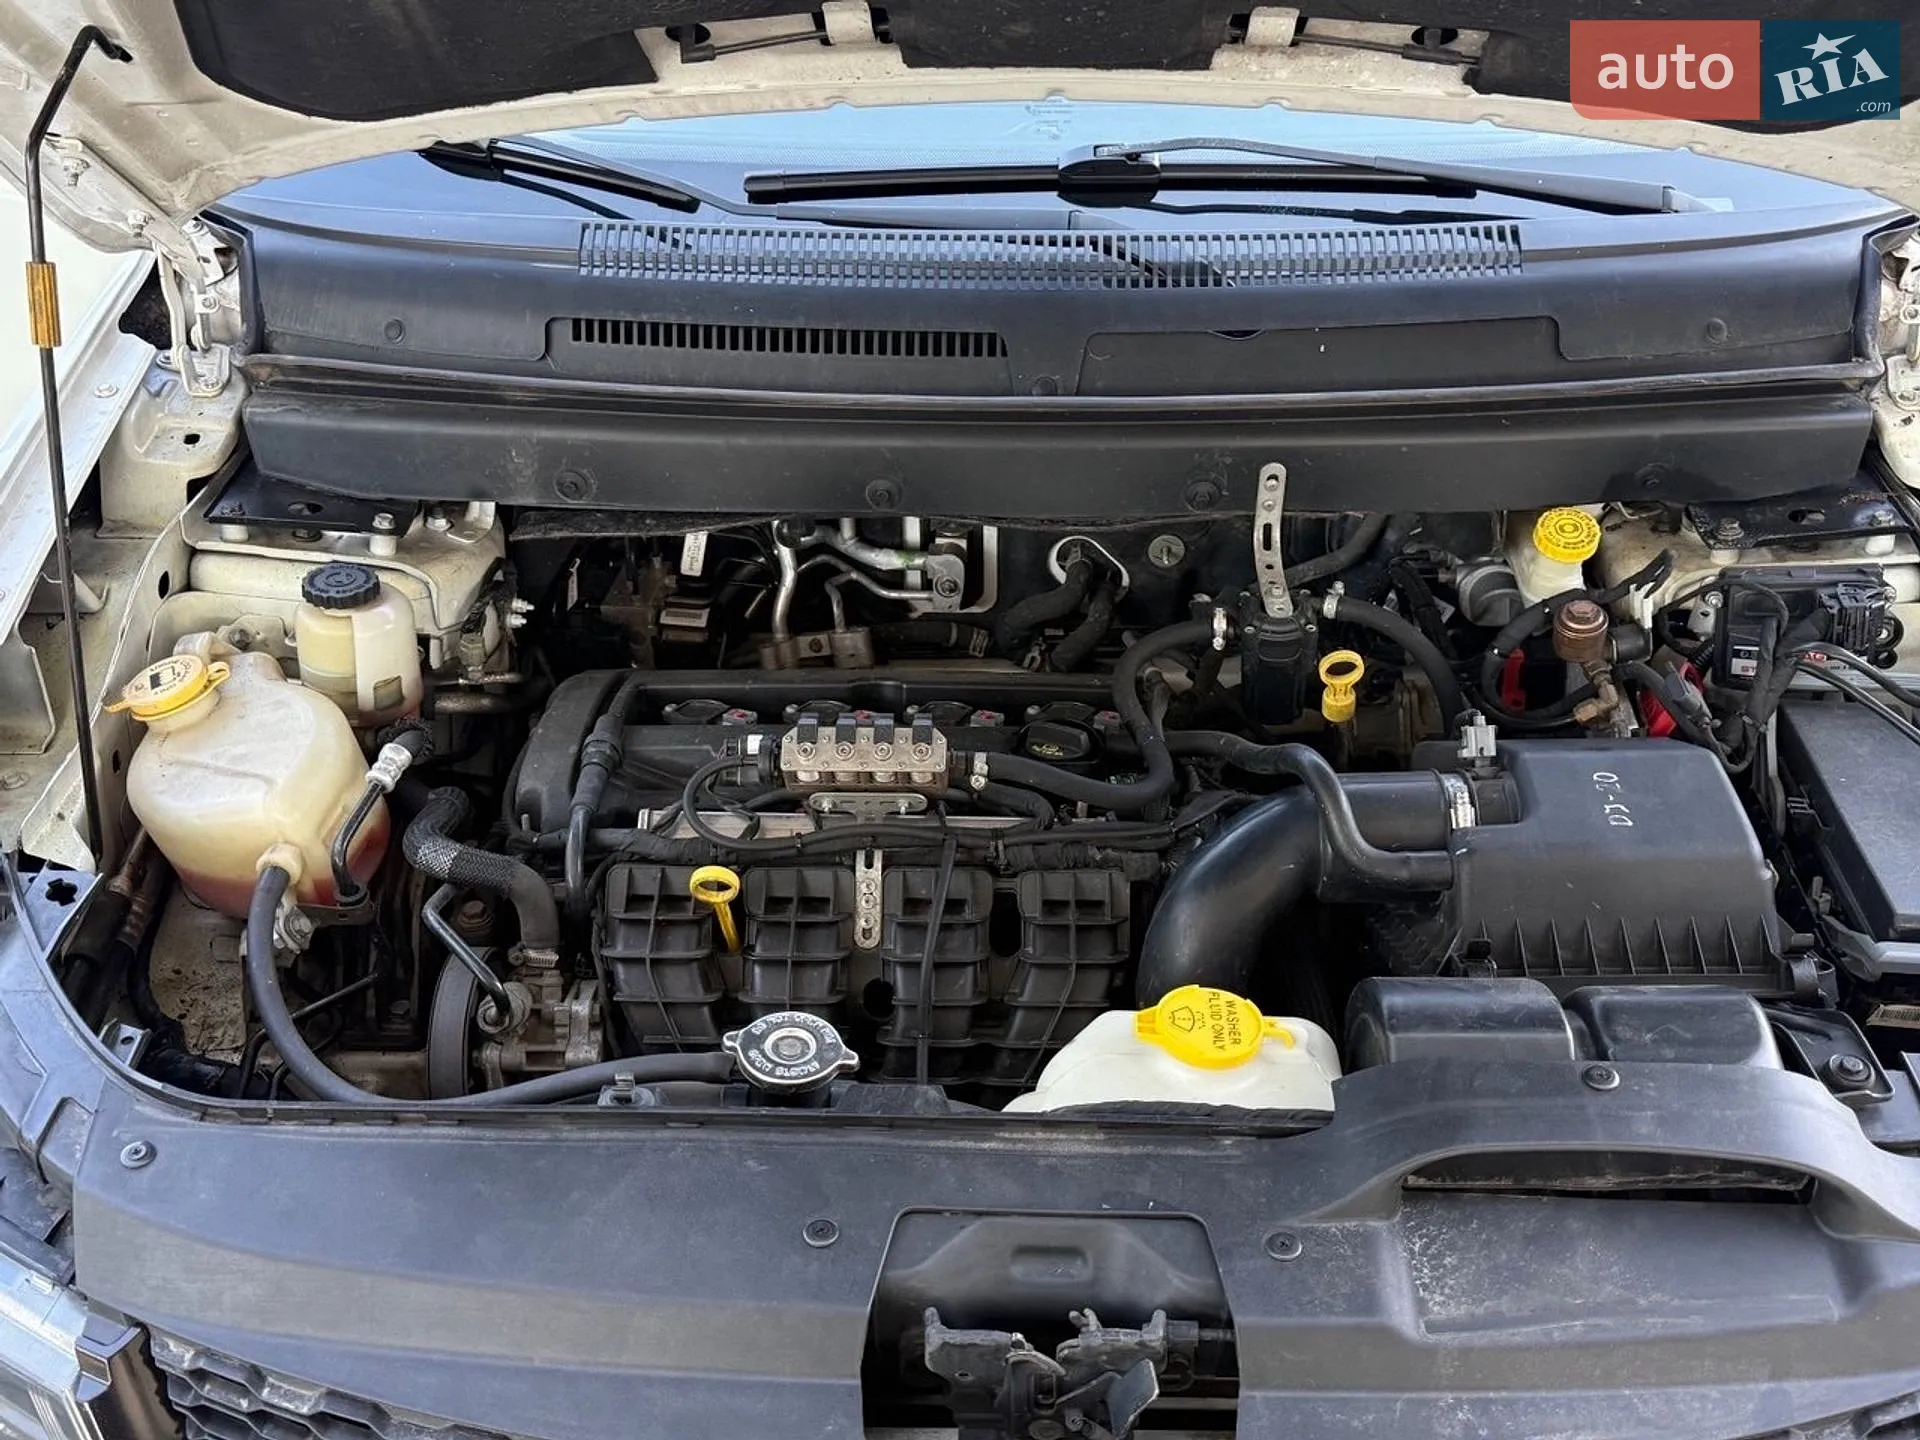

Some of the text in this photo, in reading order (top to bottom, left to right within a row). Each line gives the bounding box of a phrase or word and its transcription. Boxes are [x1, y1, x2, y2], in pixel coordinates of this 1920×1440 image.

[1208, 991, 1226, 1051] FLUID ONLY
[1225, 999, 1242, 1046] WASHER
